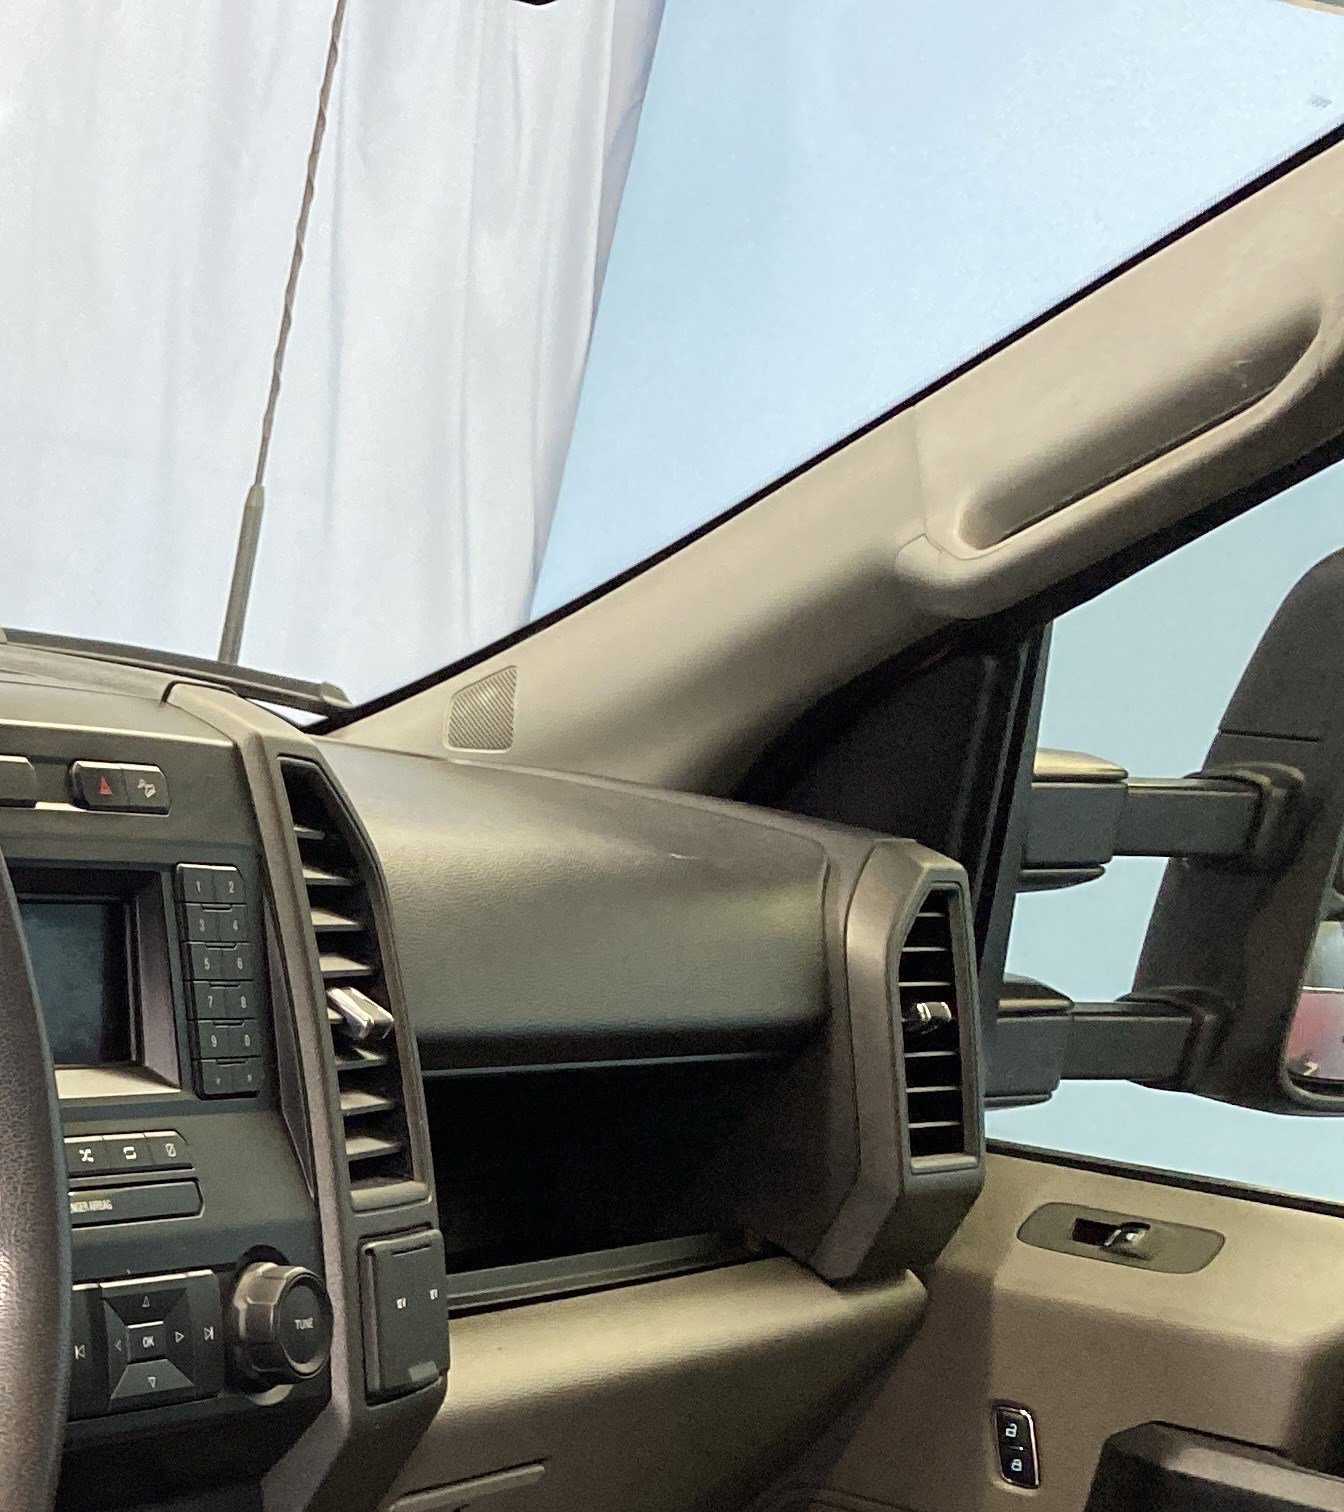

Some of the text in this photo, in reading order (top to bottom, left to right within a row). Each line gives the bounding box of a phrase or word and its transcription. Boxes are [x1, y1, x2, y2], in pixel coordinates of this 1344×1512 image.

[228, 880, 235, 894] 2
[203, 957, 210, 970] 5
[236, 956, 243, 970] 6
[142, 1335, 155, 1348] OK
